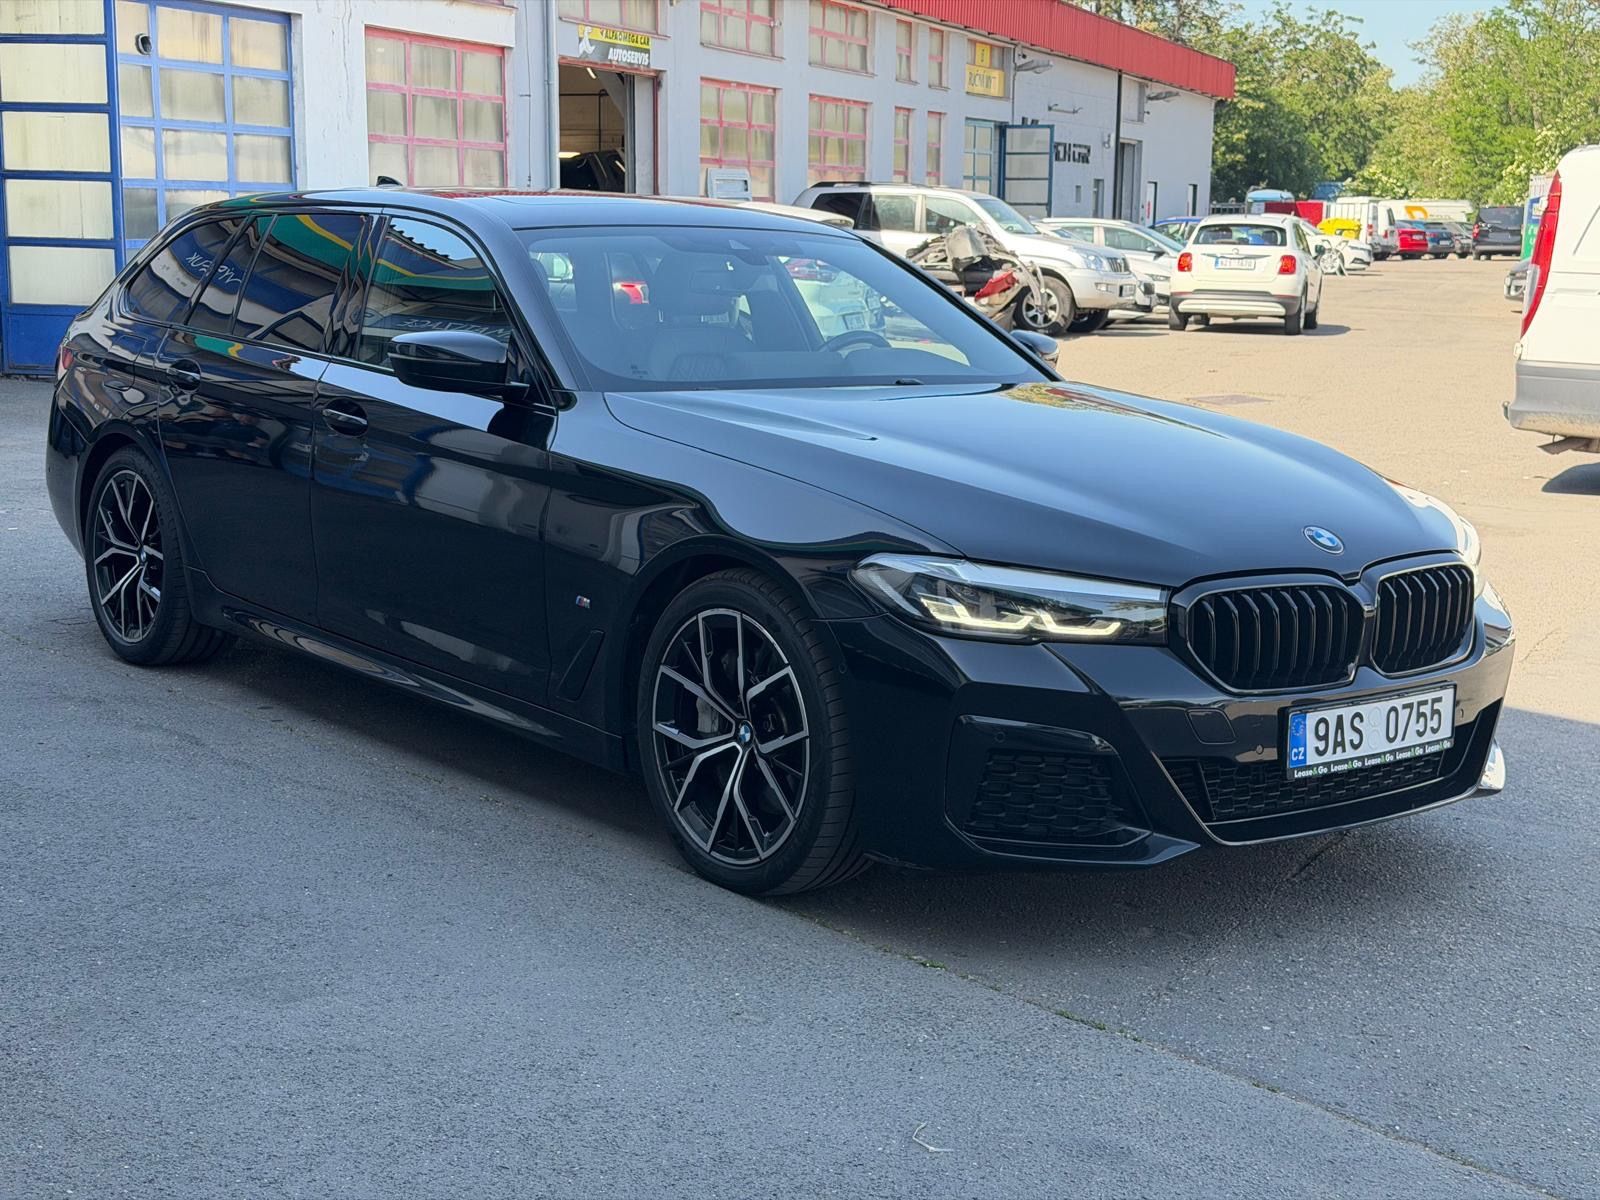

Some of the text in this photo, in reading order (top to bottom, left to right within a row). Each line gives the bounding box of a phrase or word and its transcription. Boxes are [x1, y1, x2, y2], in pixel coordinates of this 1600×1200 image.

[607, 47, 649, 65] AUTOSERVIS
[1314, 696, 1443, 757] 9AS 0755
[1291, 747, 1305, 760] CZ
